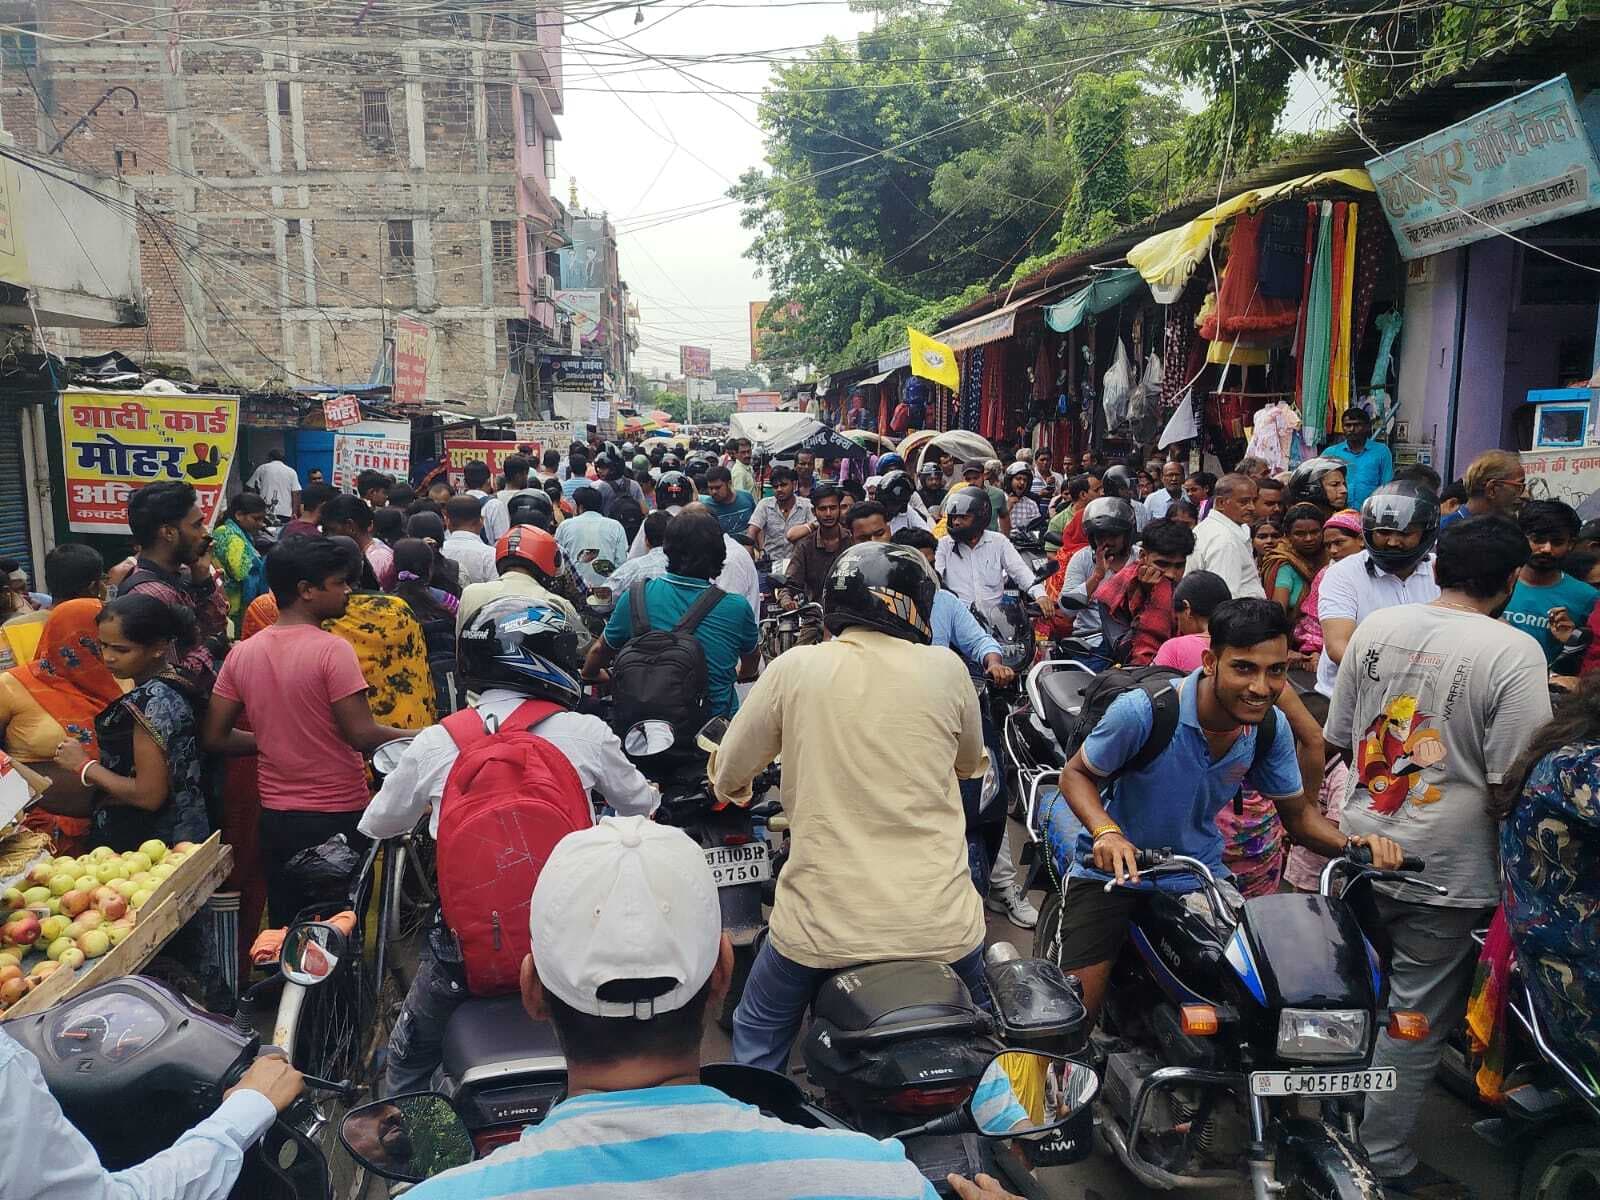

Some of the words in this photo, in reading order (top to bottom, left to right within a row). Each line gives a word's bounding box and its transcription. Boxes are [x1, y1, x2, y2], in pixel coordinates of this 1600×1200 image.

[70, 402, 152, 431] शादी
[160, 406, 231, 433] कार्ड
[553, 422, 570, 431] GST
[71, 432, 186, 478] मोहर
[713, 865, 759, 883] 9750
